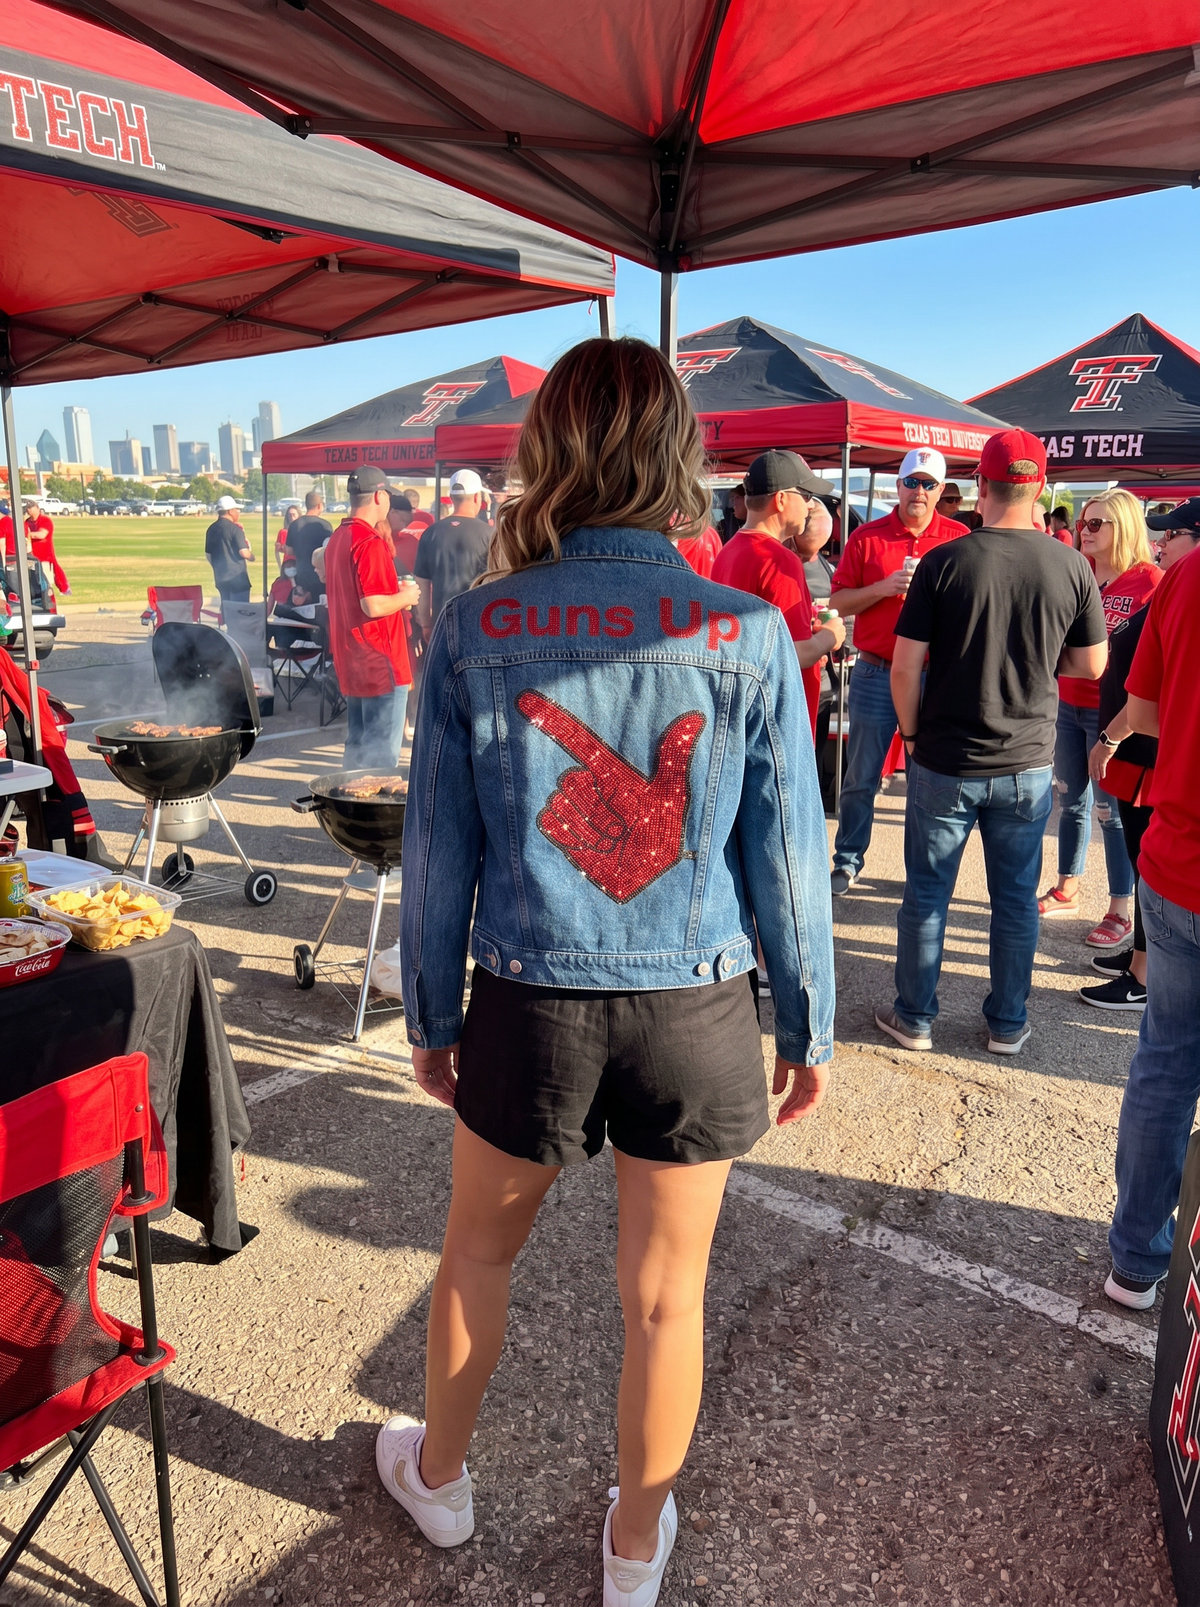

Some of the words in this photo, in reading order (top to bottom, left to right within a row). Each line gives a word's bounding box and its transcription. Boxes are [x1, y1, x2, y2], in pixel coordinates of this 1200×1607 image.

[0, 70, 155, 169] TECH
[902, 422, 930, 444] TEXAS
[930, 426, 951, 447] TECH
[1082, 434, 1144, 457] TECH
[325, 447, 358, 463] TEXAS
[362, 446, 389, 462] TECH
[392, 444, 436, 461] UNIVER
[1103, 595, 1133, 614] ECH
[480, 597, 636, 639] Guns
[659, 597, 742, 650] Up
